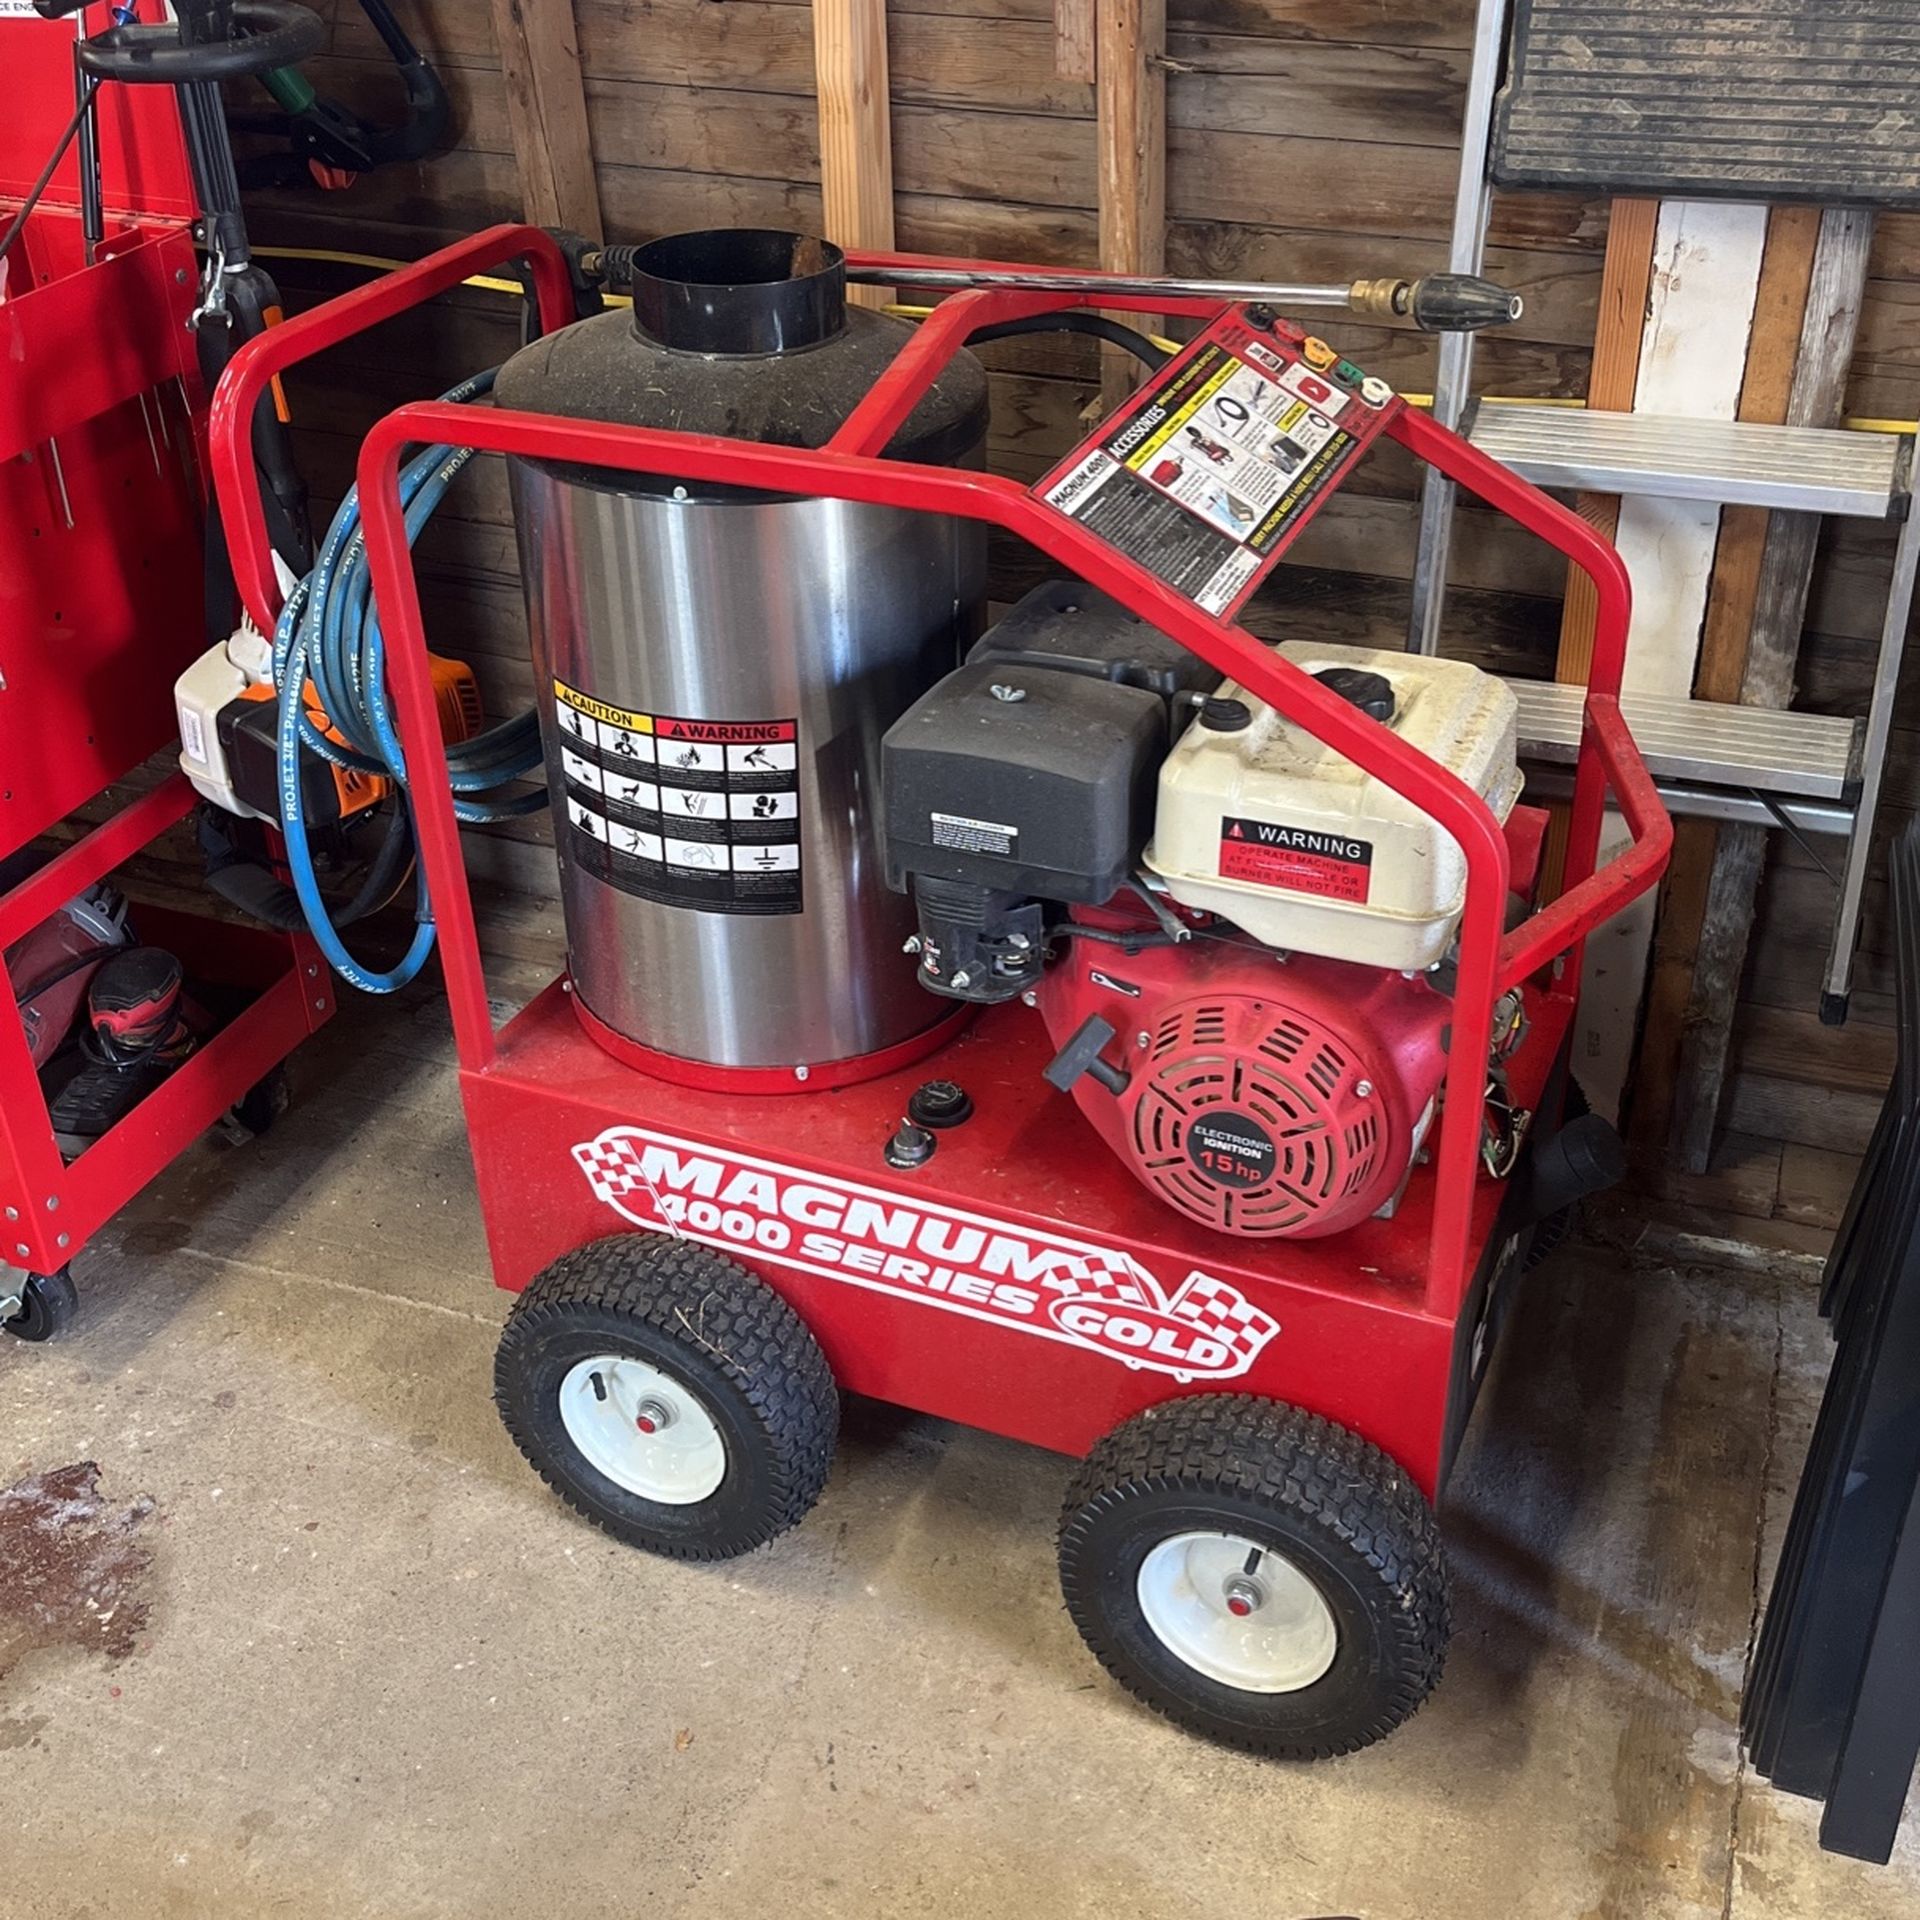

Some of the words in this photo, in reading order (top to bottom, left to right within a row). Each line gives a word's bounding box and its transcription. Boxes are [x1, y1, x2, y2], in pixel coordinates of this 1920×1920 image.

[1109, 404, 1167, 460] ACCESSORIES
[1051, 471, 1089, 506] MAGNUM
[573, 694, 633, 727] CAUTION
[688, 725, 780, 740] WARNING
[283, 764, 298, 821] PROJET
[1258, 825, 1362, 859] WARNING
[1229, 855, 1243, 864] AT
[1341, 876, 1359, 886] OR
[1239, 846, 1291, 862] OPERATE
[1296, 854, 1349, 874] MACHINE
[1225, 865, 1272, 881] BURNER
[1275, 873, 1302, 887] WILL
[1306, 878, 1330, 891] NOT
[1334, 885, 1361, 898] FIRE
[1193, 1125, 1273, 1153] ELECTRONIC
[1203, 1137, 1262, 1160] IGNITION
[643, 1145, 1067, 1283] MAGNUM
[653, 1194, 791, 1250] 4000
[800, 1233, 1039, 1315] SERIES
[1058, 1303, 1229, 1369] GOLD
